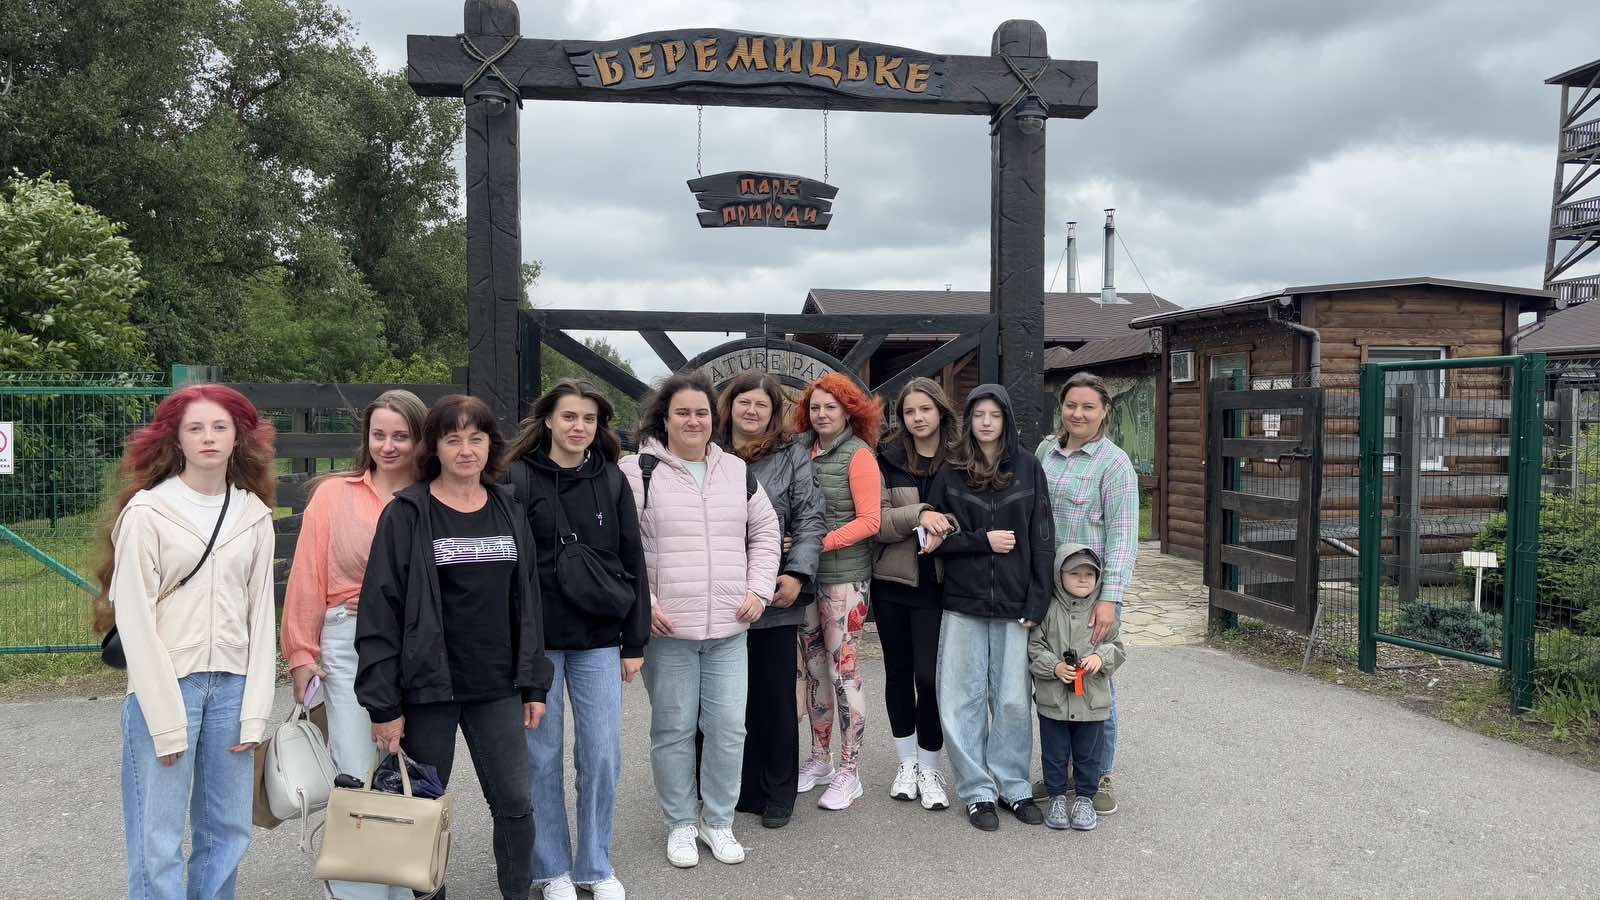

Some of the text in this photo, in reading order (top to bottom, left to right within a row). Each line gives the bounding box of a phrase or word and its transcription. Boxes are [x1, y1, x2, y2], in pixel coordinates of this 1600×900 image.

[593, 36, 931, 93] БЕРЕМИЦЬКЕ
[740, 177, 800, 203] ПАРК
[722, 201, 818, 226] ПРИРОДИ
[710, 352, 781, 383] ATURE
